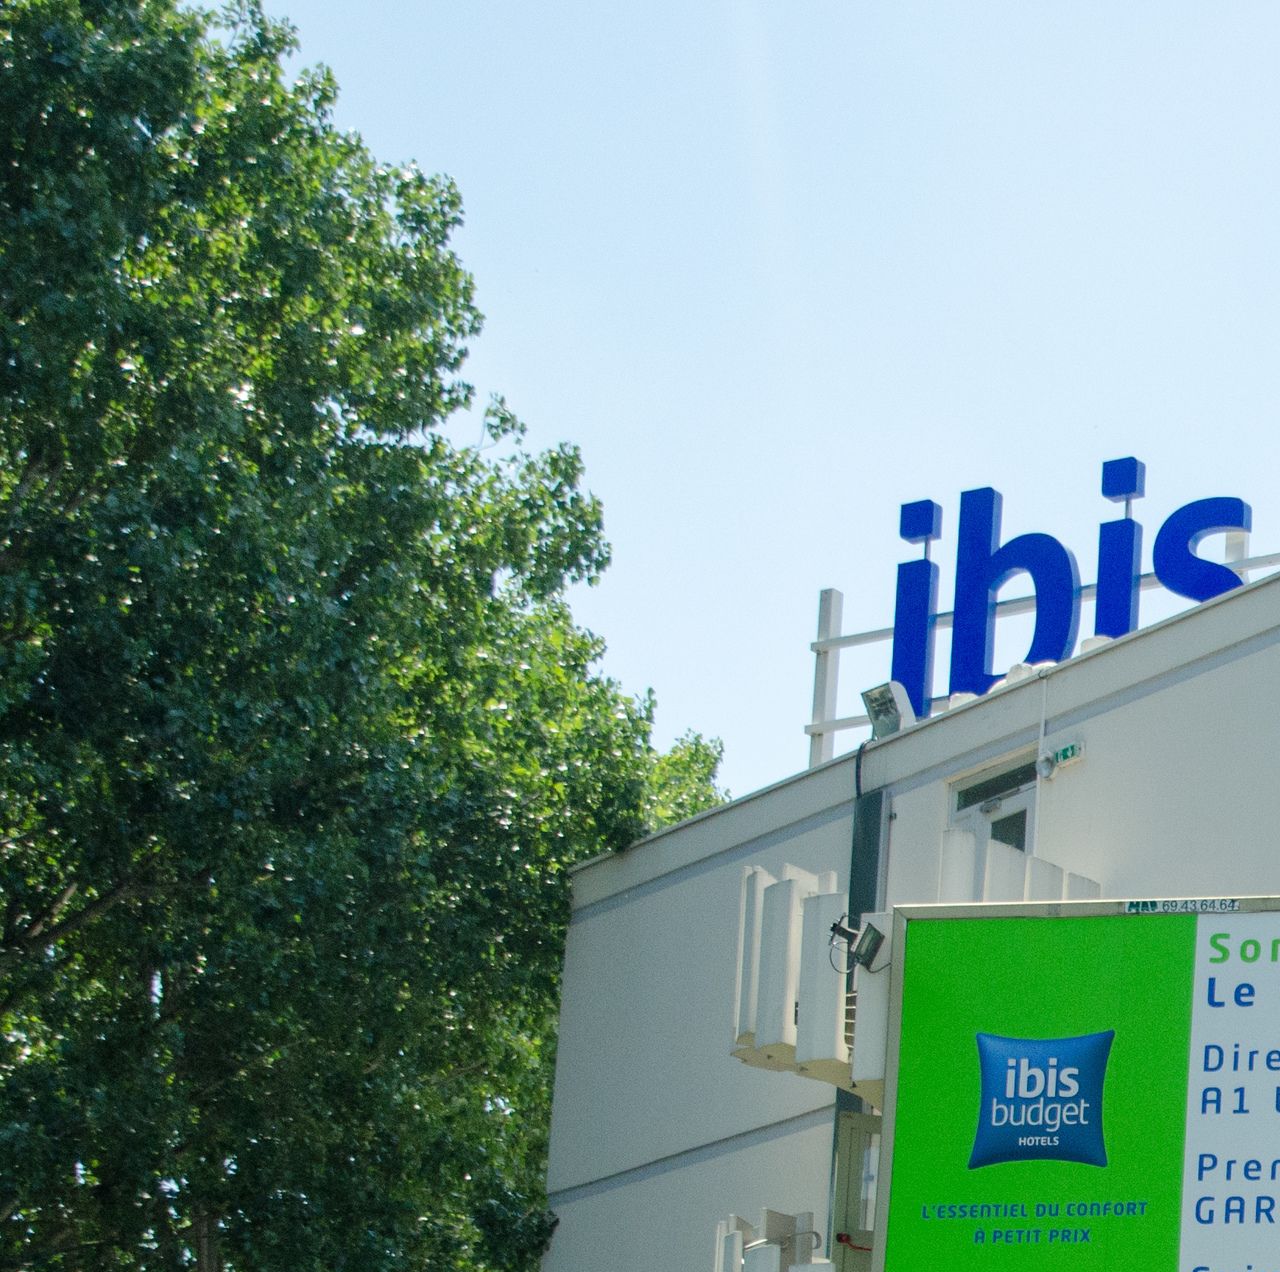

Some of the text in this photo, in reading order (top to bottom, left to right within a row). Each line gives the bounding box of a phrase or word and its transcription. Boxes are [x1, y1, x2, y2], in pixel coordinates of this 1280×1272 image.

[890, 456, 1251, 719] ibis
[1207, 976, 1256, 1008] Le
[1005, 1057, 1080, 1099] ibis
[991, 1097, 1090, 1132] budget
[1201, 1086, 1250, 1115] A1
[1018, 1136, 1060, 1146] HOTELS
[921, 1201, 1149, 1219] L'ESSENTIEL DU CONFORT
[974, 1228, 1091, 1244] À PETIT PRIX
